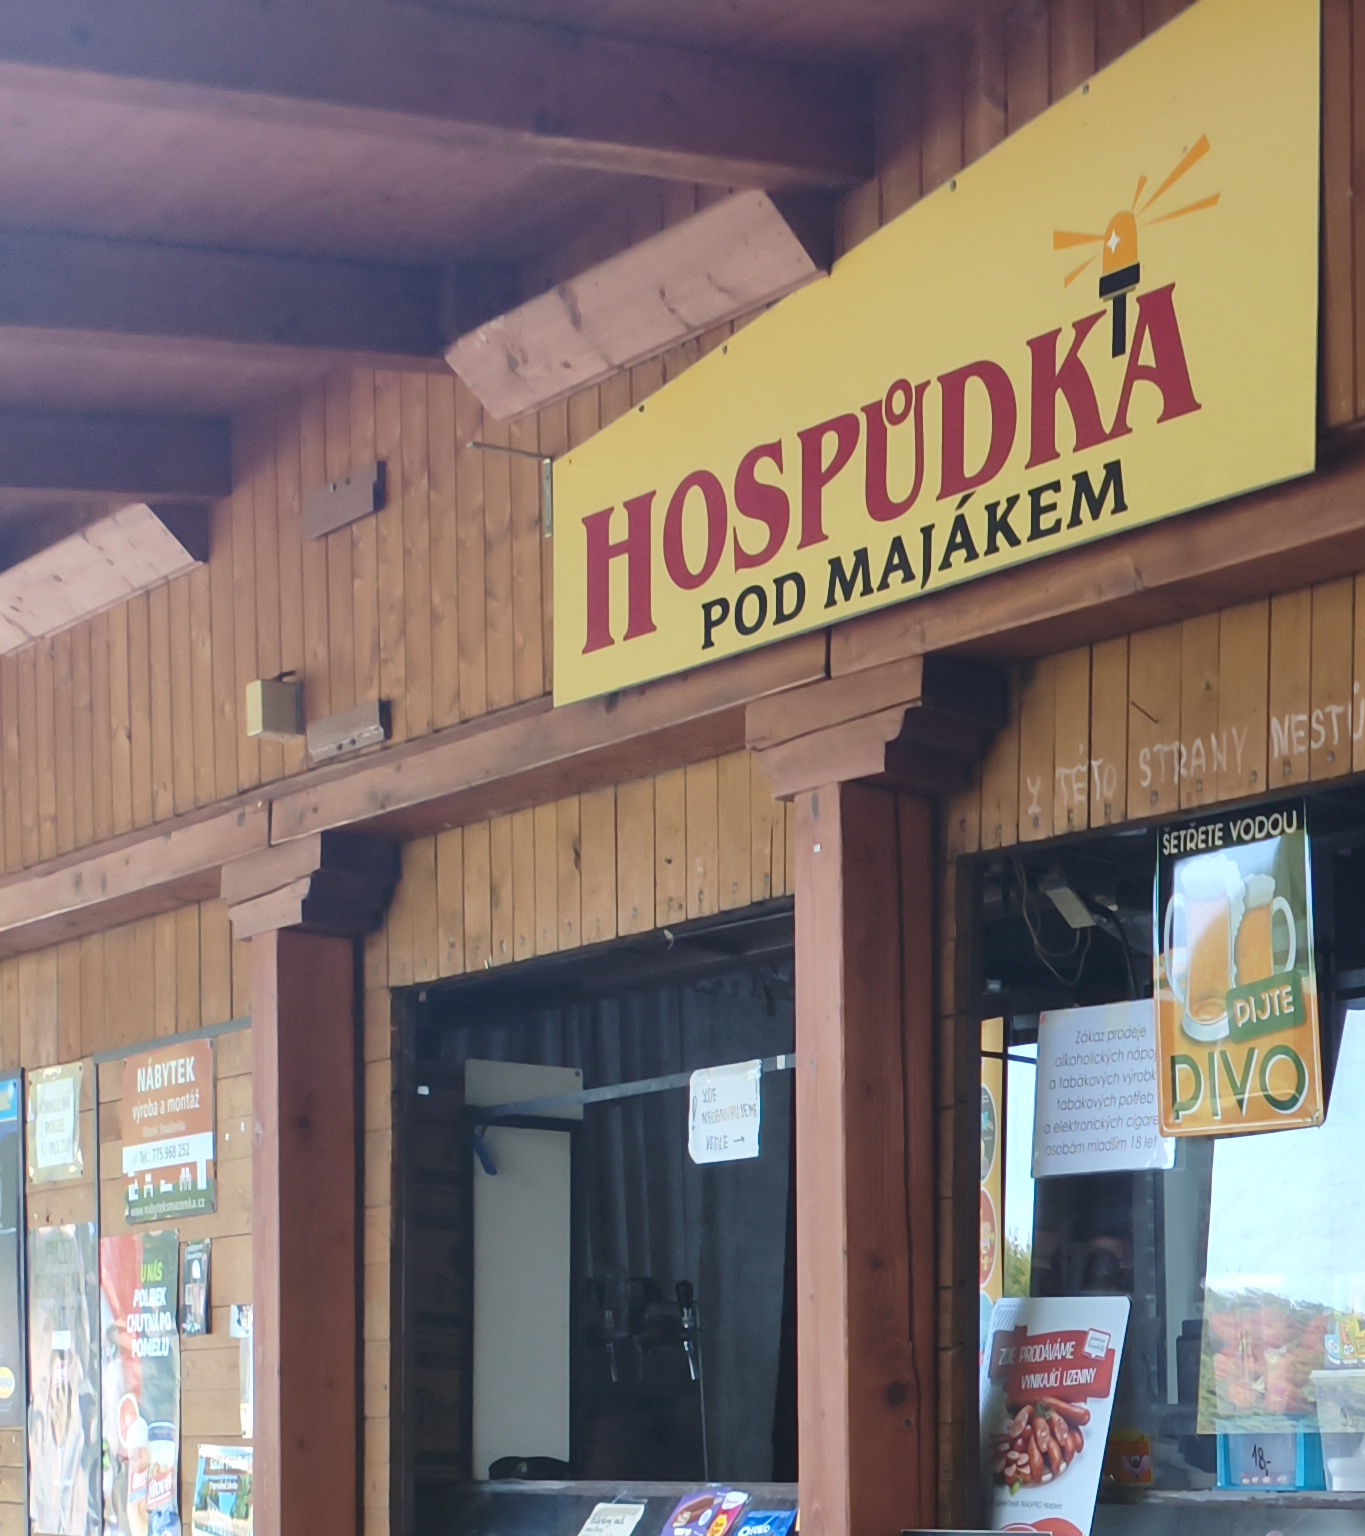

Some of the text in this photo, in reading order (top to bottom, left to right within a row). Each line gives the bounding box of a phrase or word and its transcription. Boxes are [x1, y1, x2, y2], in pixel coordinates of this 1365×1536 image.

[581, 281, 1202, 656] HOSPŮDKA
[702, 460, 1128, 650] POD MAJÁKEM
[1138, 725, 1248, 789] STRANY
[1162, 810, 1298, 856] ŠETŘETE VODOU
[1234, 985, 1295, 1029] PIJTE
[1075, 1024, 1146, 1045] Zákaz prodeje
[1056, 1049, 1123, 1068] alkoholických
[137, 1056, 196, 1092] NÁBYTEK
[1049, 1079, 1056, 1090] a
[1060, 1070, 1120, 1089] tabákových
[1170, 1045, 1309, 1123] PIVO
[132, 1088, 200, 1125] výroba a montáž
[1058, 1089, 1154, 1111] tabákových potřeb
[1044, 1123, 1051, 1134] a
[1053, 1113, 1123, 1133] elektronických
[1045, 1134, 1157, 1156] osobám mladším 18 let
[133, 1287, 167, 1308] POLIBEK
[159, 1311, 172, 1332] PO
[131, 1338, 169, 1358] POMELU
[998, 1338, 1076, 1366] ZDE PRODÁVÁME
[1021, 1366, 1097, 1391] VYNIKAJÍCÍ UZENINY
